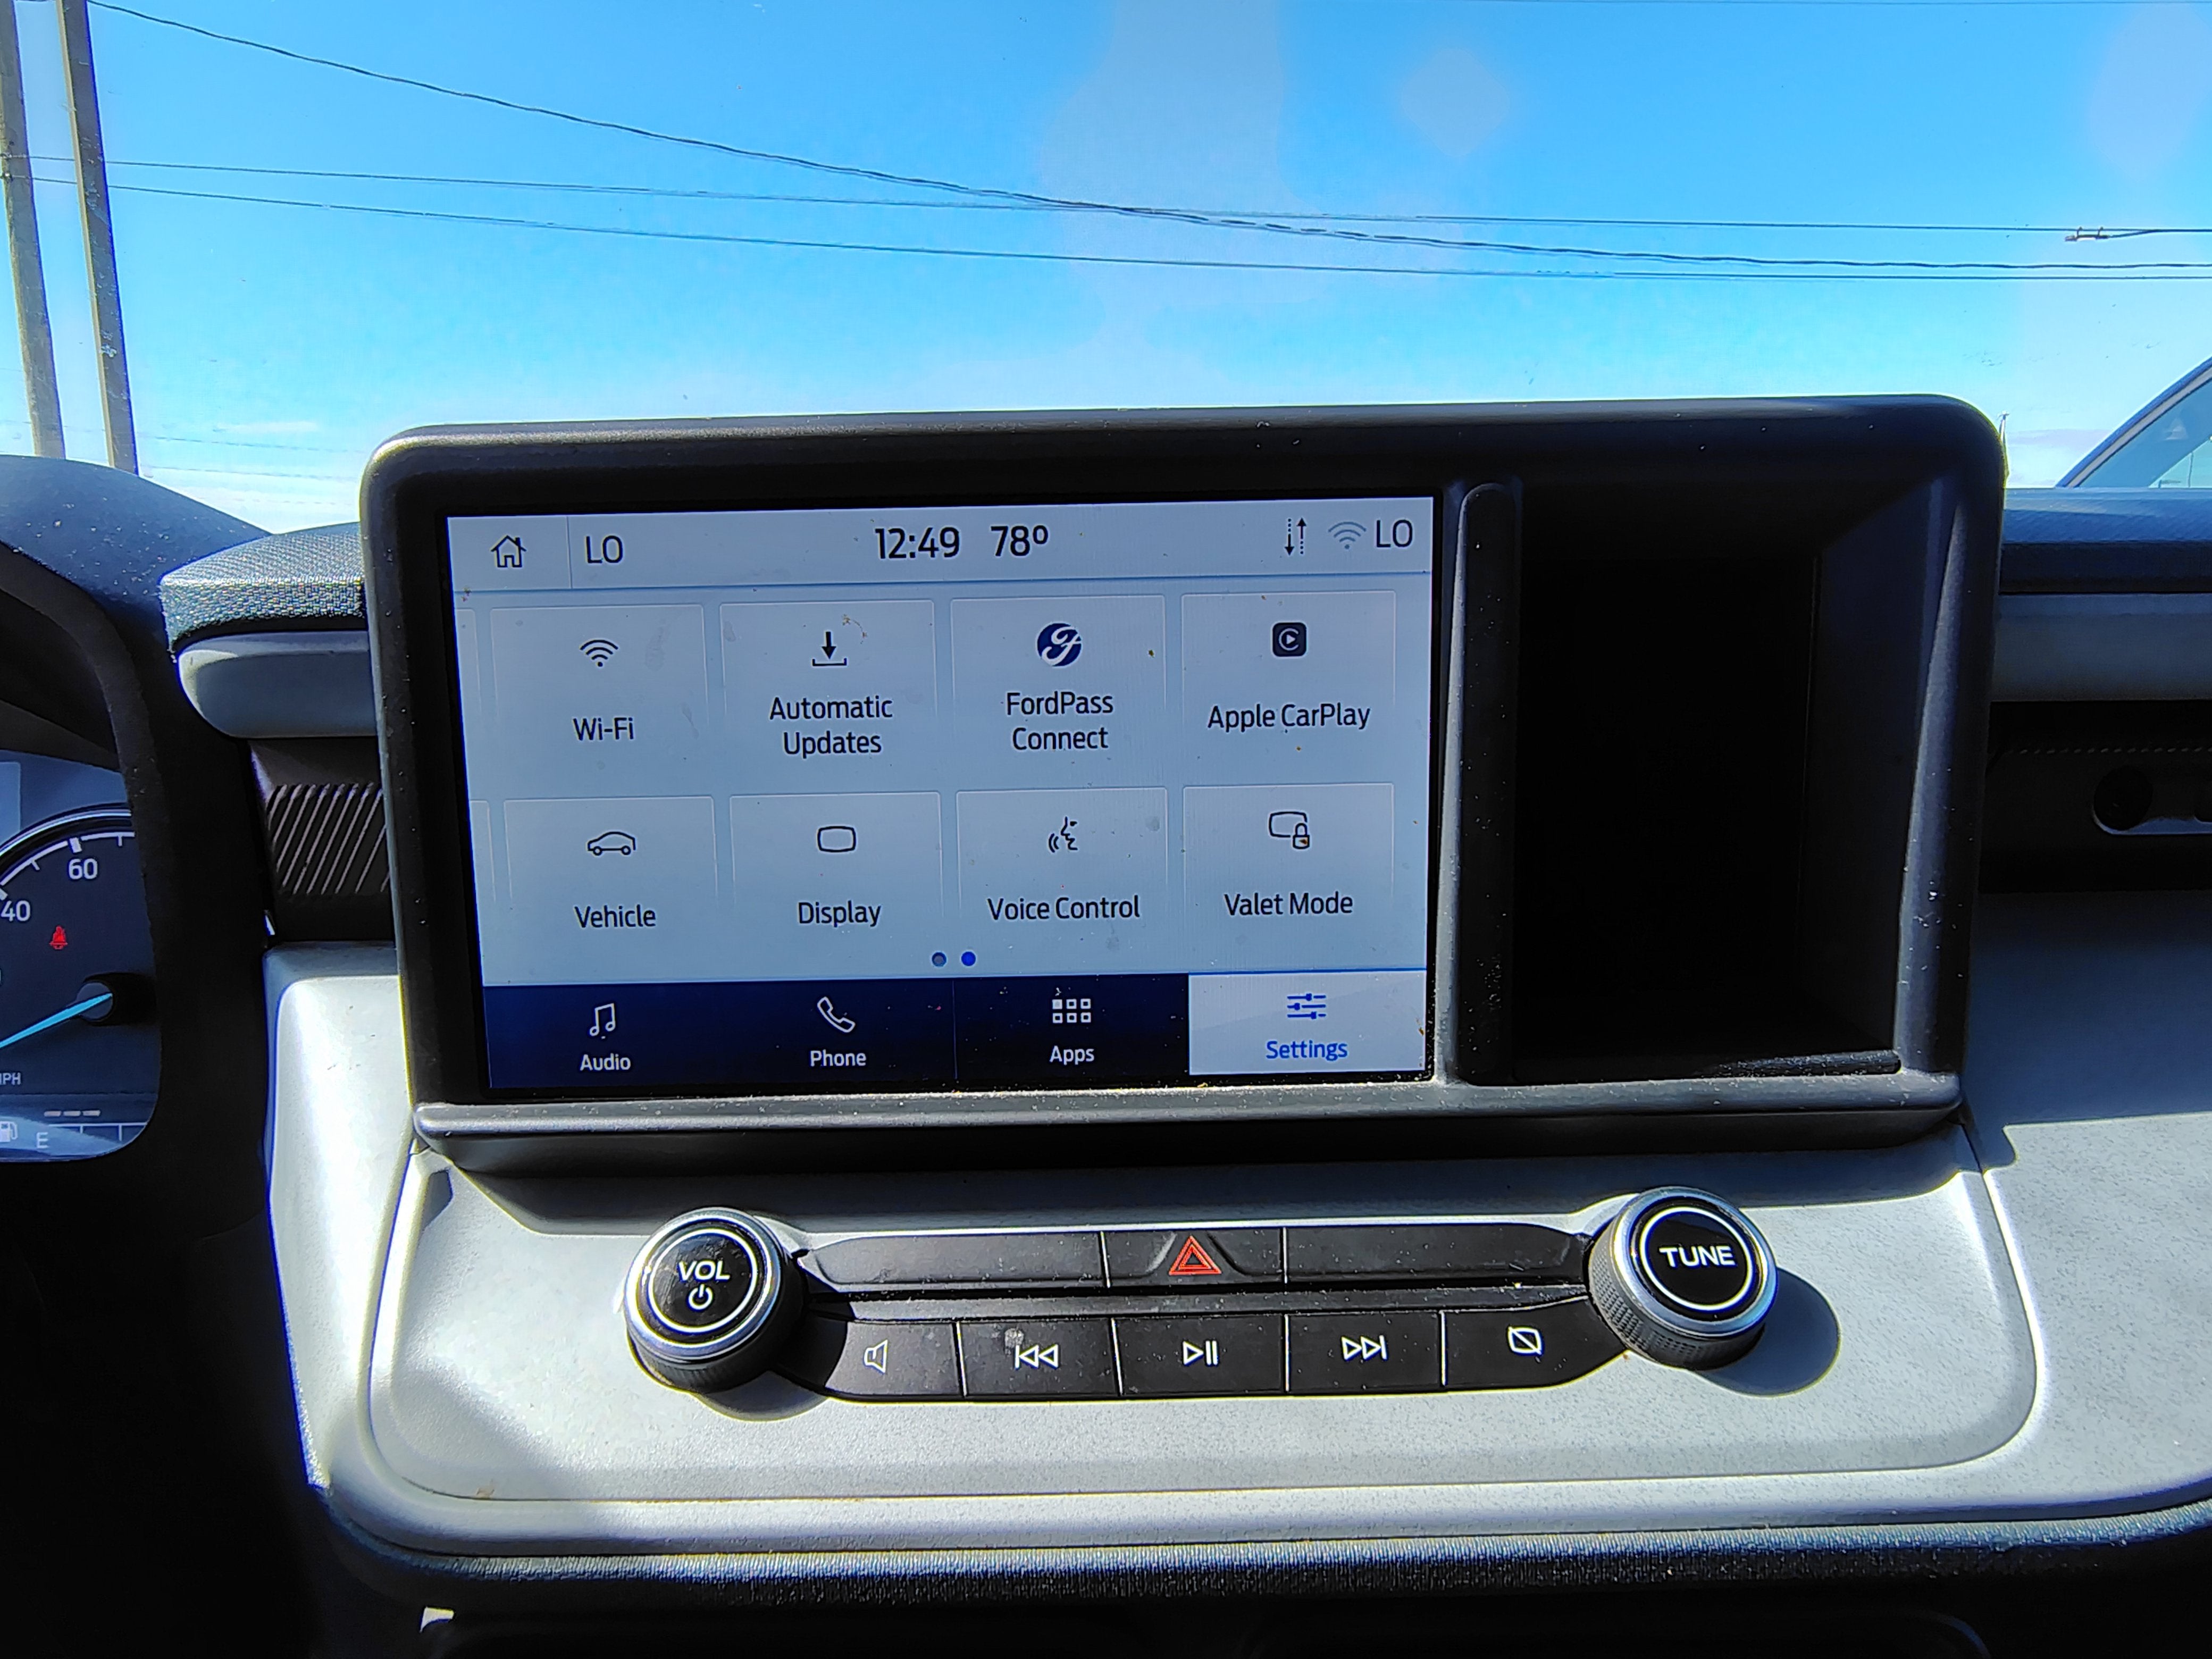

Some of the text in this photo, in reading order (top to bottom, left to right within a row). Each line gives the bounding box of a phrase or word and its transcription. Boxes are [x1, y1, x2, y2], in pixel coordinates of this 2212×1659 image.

[875, 527, 959, 559] 12:49
[1377, 520, 1412, 547] LO
[586, 535, 623, 563] LO
[770, 696, 892, 719] Automatic
[1008, 691, 1113, 715] FordPass
[1208, 702, 1370, 732] Apple CarPlay
[573, 718, 633, 740] Wi-Fi
[1013, 727, 1108, 750] Connect
[784, 731, 881, 759] Updates
[69, 859, 97, 879] 60
[1, 901, 30, 921] 40
[799, 900, 881, 927] Display
[987, 895, 1139, 920] Voice Control
[1225, 891, 1352, 915] Valet Mode
[575, 904, 656, 927] Vehicle
[580, 1053, 631, 1070] Audio
[811, 1050, 866, 1066] Phone
[1050, 1046, 1094, 1065] Apps
[1266, 1040, 1347, 1061] Settings
[0, 1073, 21, 1085] PH
[37, 1132, 49, 1149] E
[1660, 1246, 1735, 1267] TUNE
[679, 1261, 730, 1280] VOL
